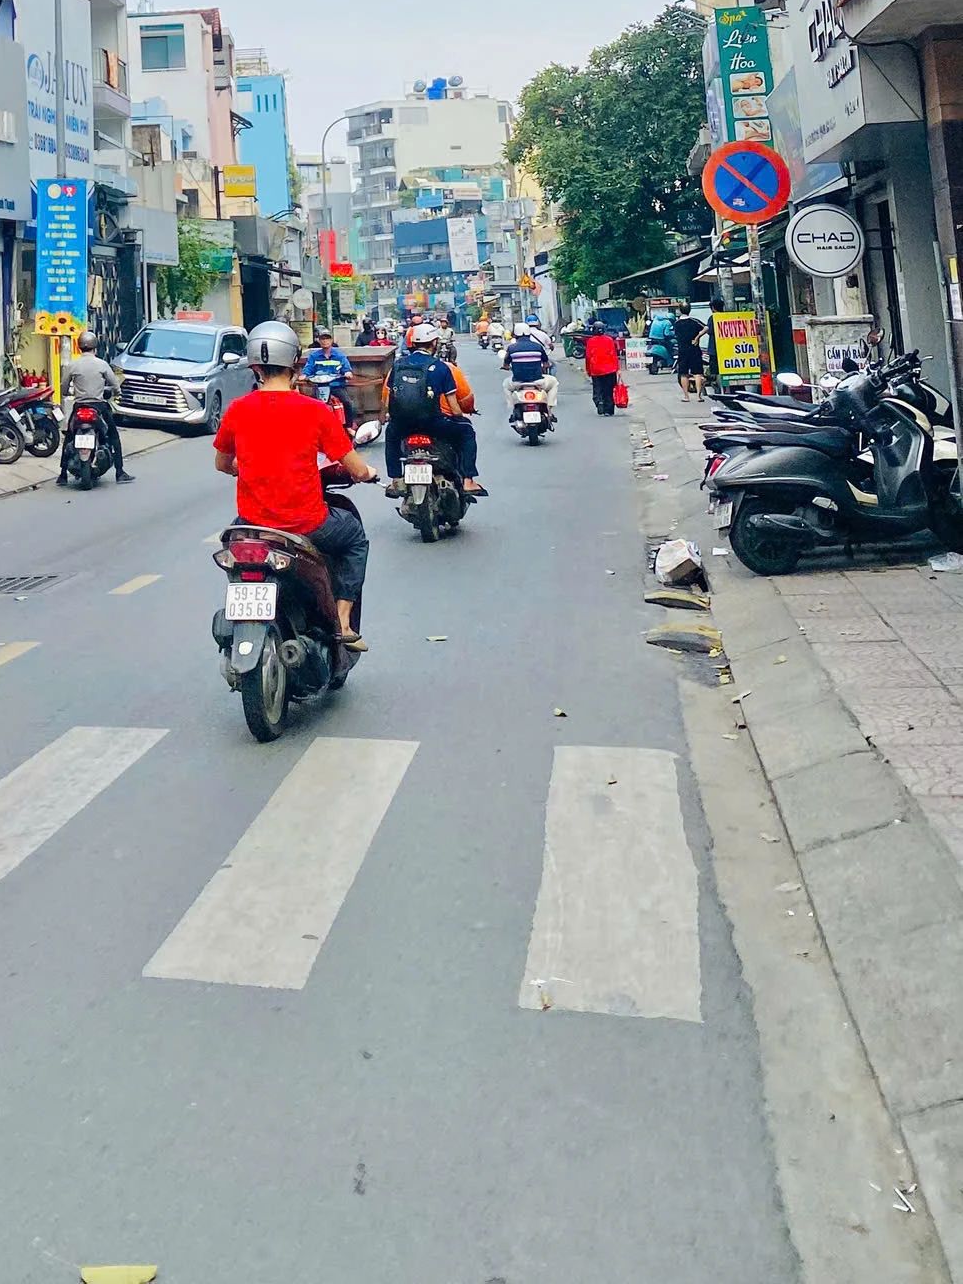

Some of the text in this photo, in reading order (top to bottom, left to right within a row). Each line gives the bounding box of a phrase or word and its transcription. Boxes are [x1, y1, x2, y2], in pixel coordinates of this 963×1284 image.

[719, 10, 743, 27] Spa
[729, 52, 756, 70] Hoa
[797, 232, 855, 243] CHAD
[735, 340, 754, 354] SỬA
[234, 586, 268, 601] 59-E2
